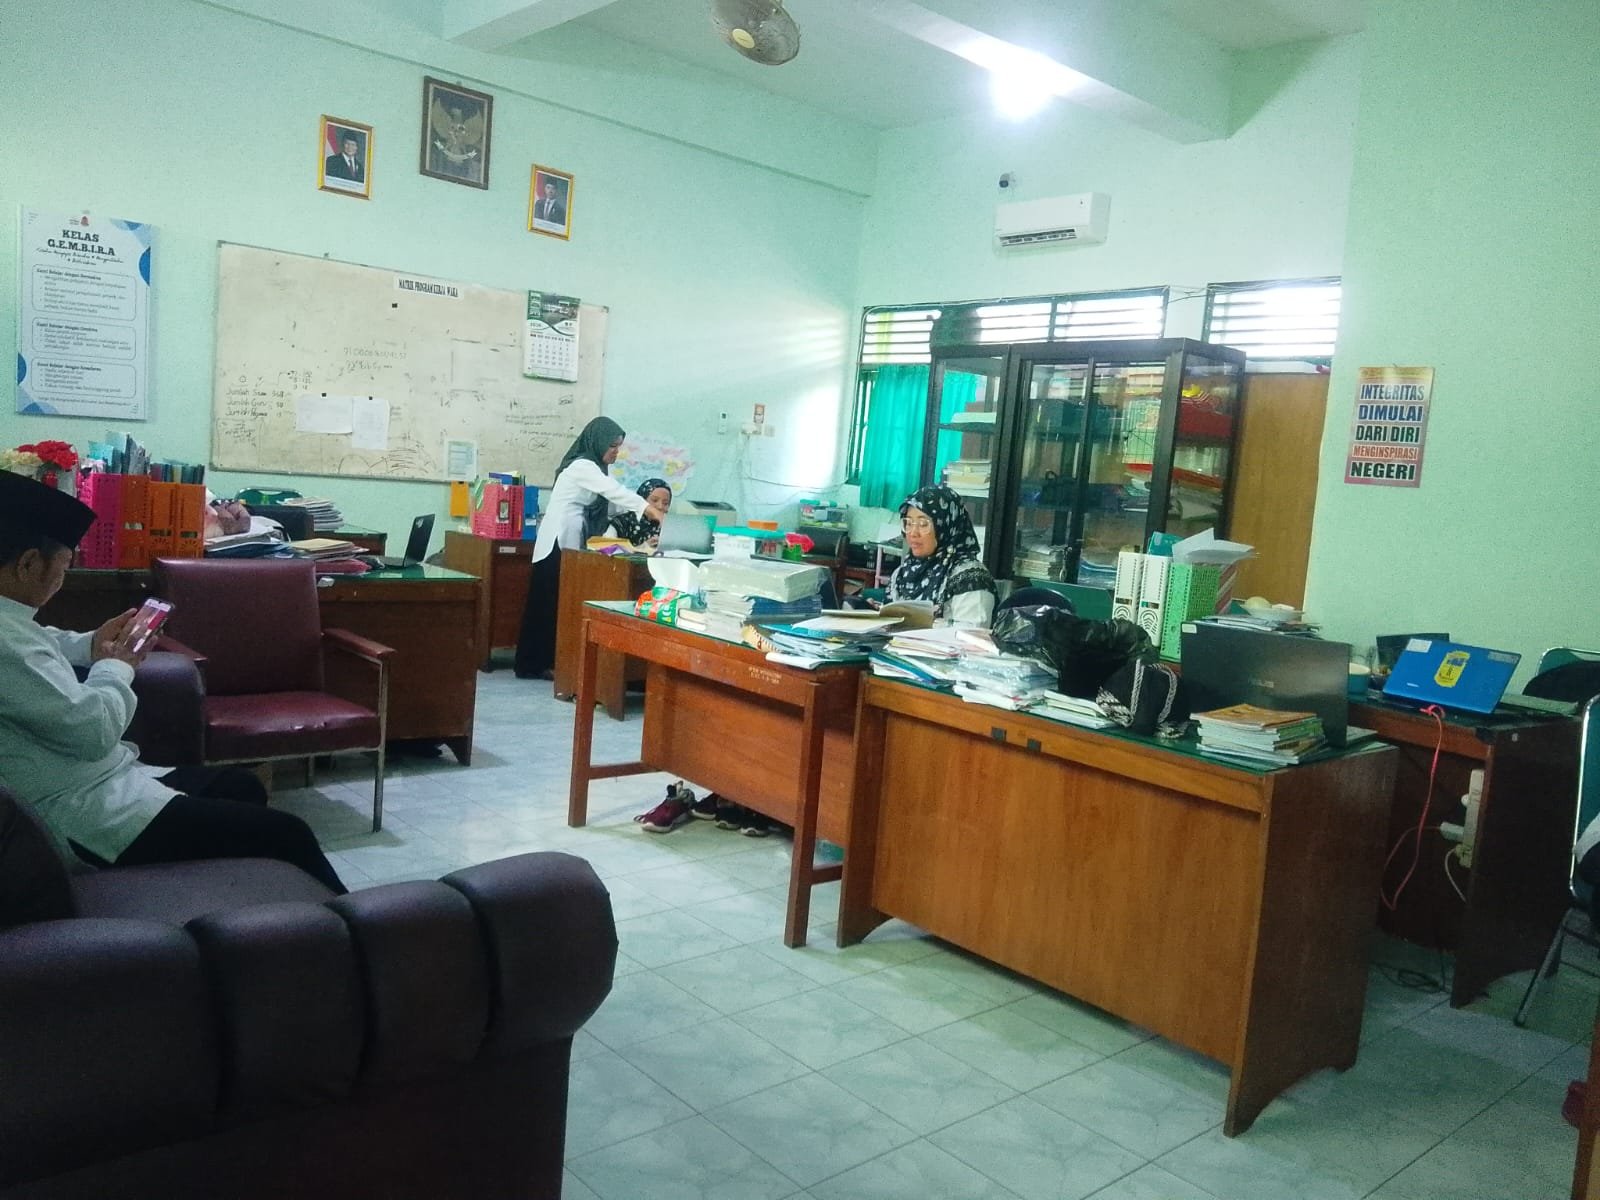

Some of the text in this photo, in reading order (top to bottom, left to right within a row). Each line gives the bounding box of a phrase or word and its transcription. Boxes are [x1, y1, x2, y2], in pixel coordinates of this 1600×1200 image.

[62, 229, 100, 242] KELAS
[47, 239, 115, 256] G.E.M.B.I.R.A
[447, 286, 459, 298] WAKA
[1360, 384, 1425, 401] INTEGRITAS
[1359, 404, 1424, 421] DIMULAI
[1356, 425, 1420, 443] DARI DIRI
[1353, 445, 1418, 459] MENGINSPIRASI
[1350, 461, 1416, 480] NEGERI
